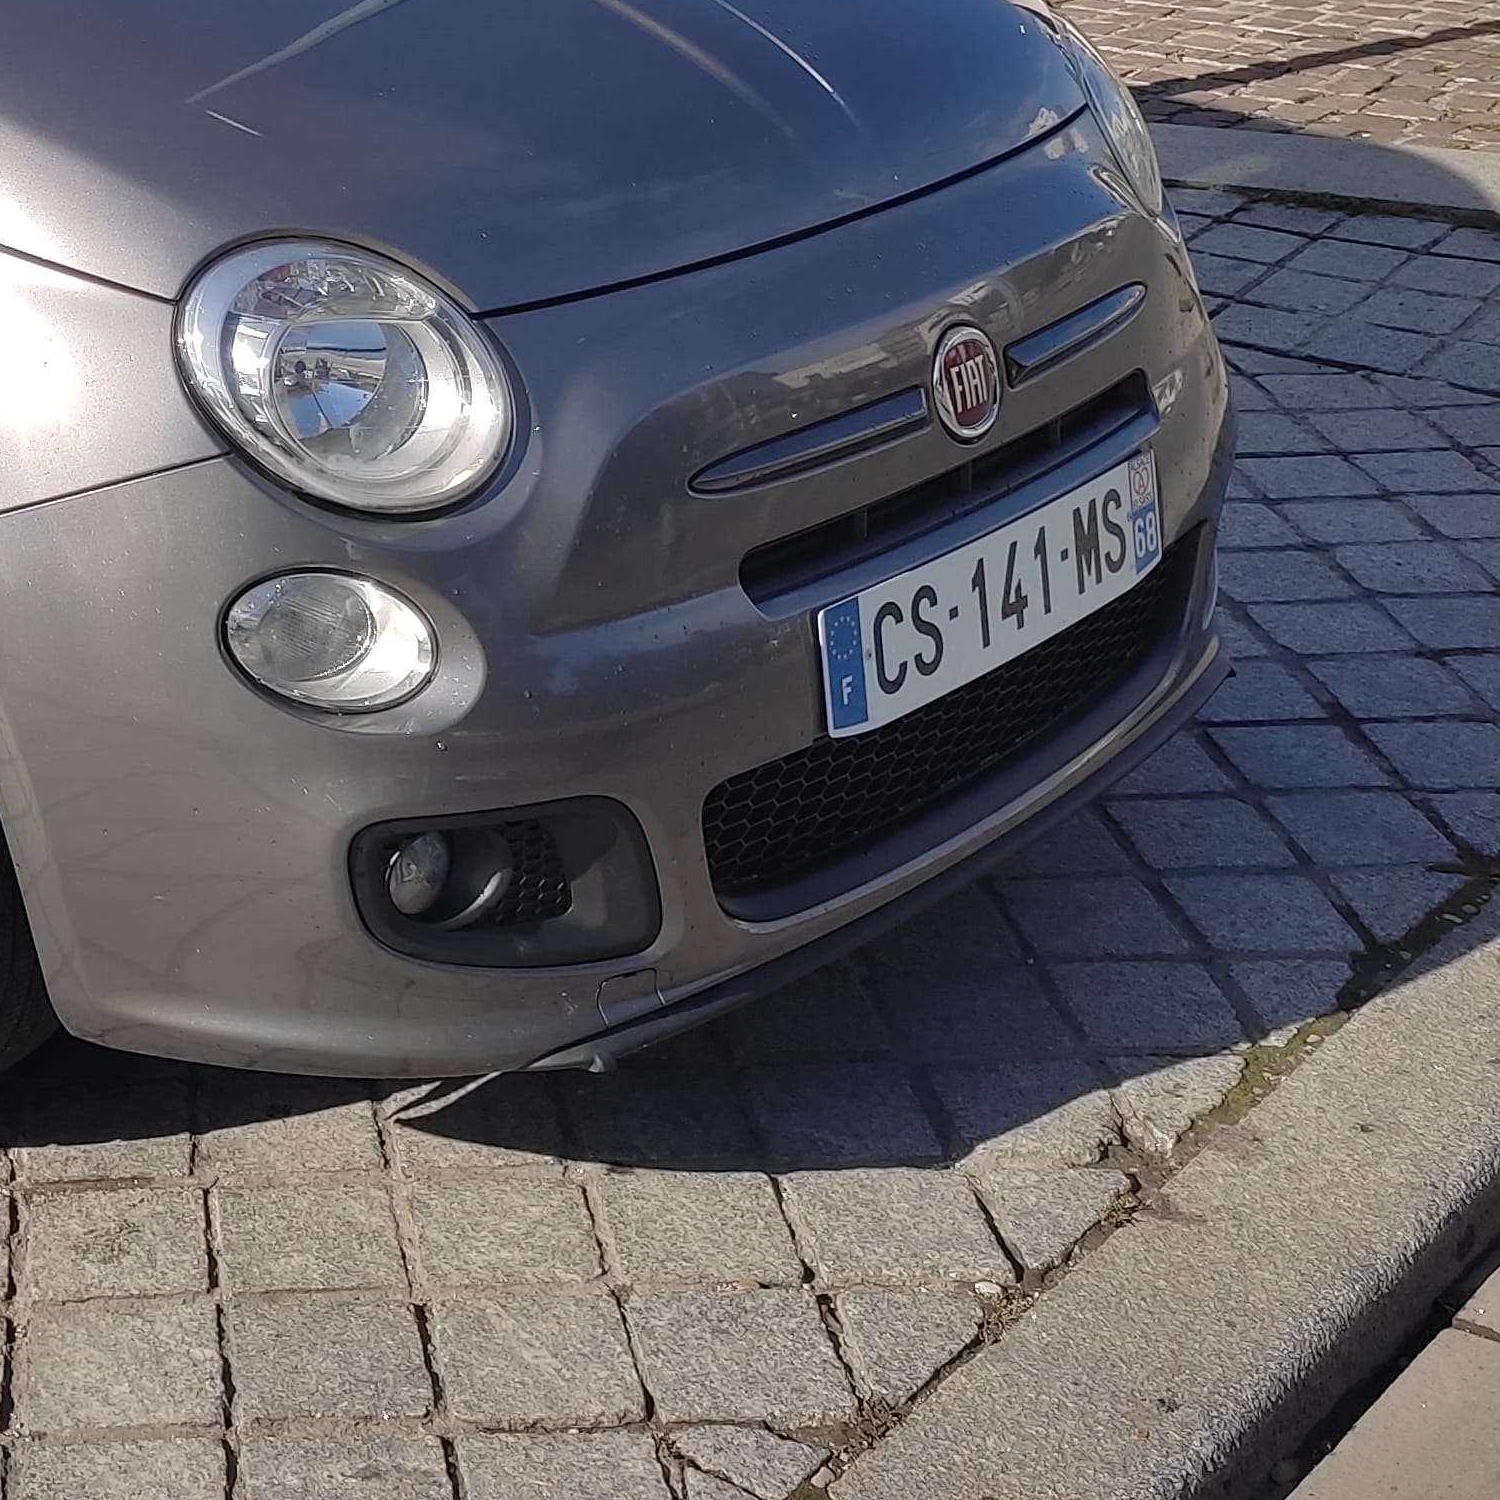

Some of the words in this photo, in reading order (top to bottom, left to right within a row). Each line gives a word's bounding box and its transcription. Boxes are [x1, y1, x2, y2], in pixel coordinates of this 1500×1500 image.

[949, 354, 988, 413] FIAT
[1134, 511, 1157, 559] 68
[873, 488, 1127, 695] CS-141-MS
[841, 675, 853, 705] F
